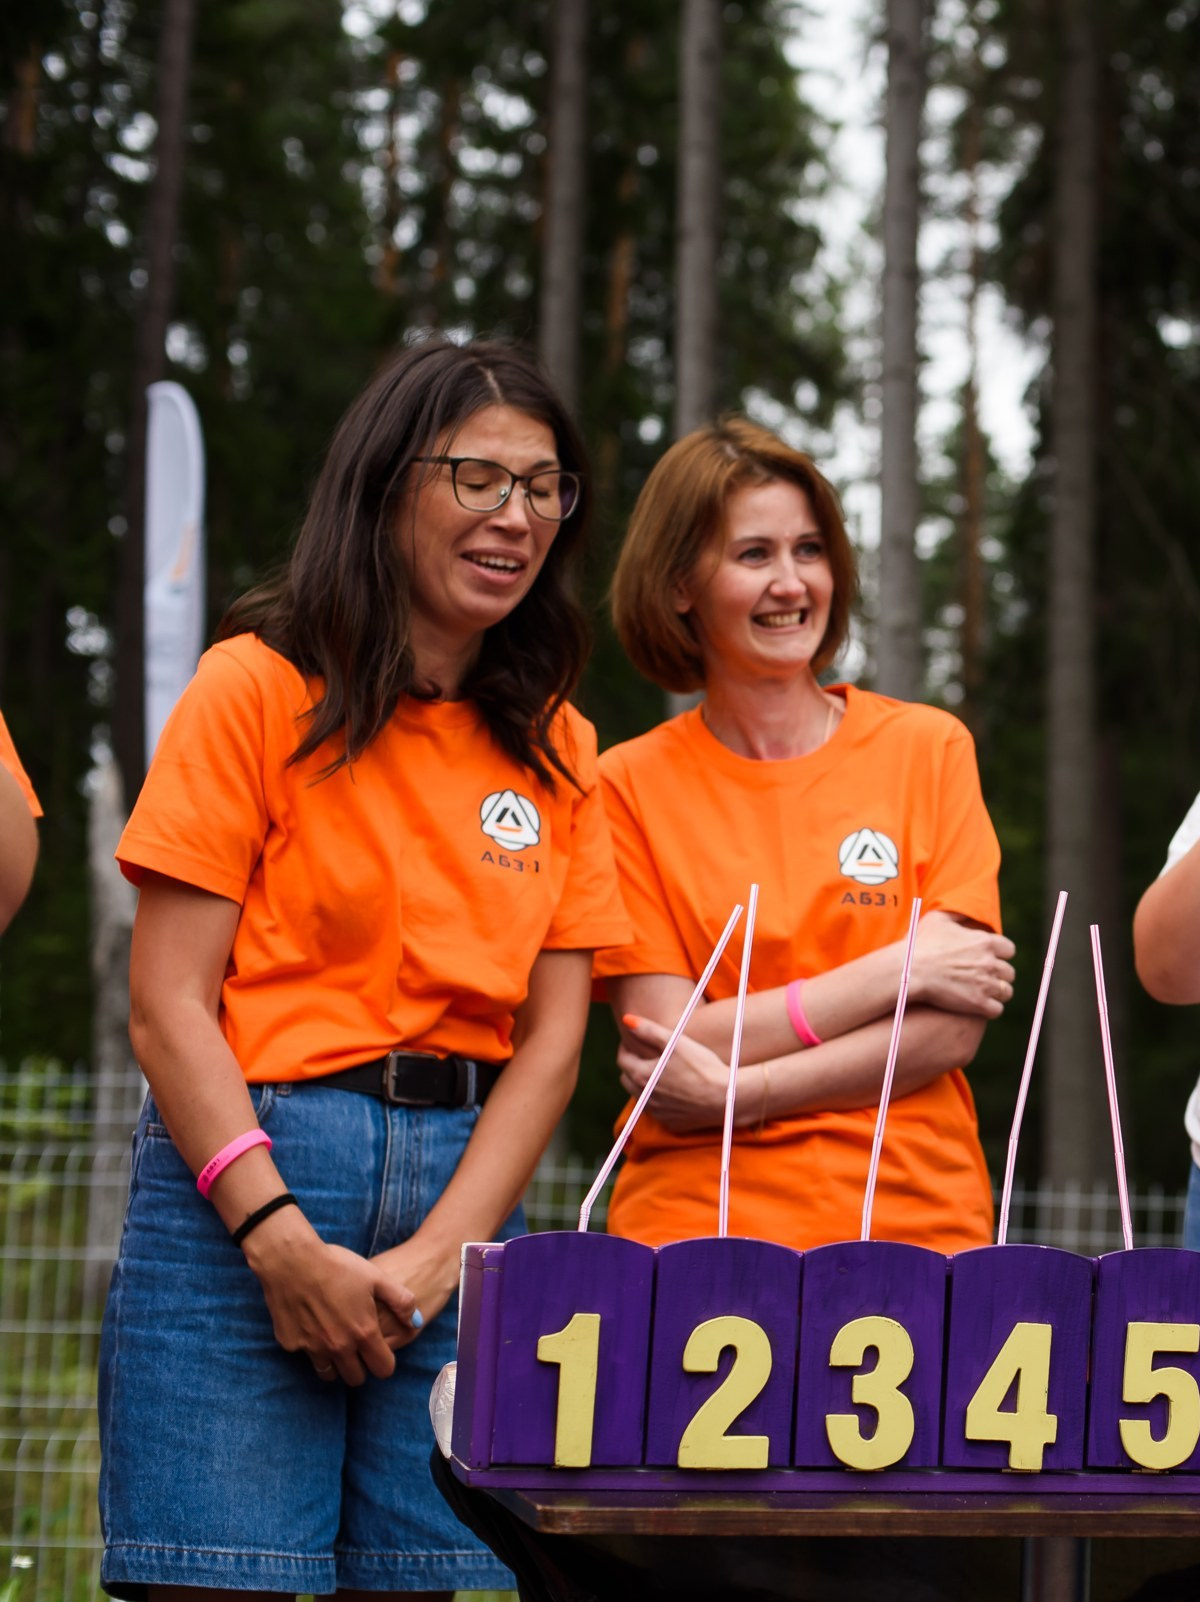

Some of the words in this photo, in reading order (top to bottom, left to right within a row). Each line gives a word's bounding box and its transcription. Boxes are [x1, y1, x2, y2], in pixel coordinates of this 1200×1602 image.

[537, 1313, 601, 1468] 1
[677, 1316, 773, 1470] 2
[825, 1316, 915, 1471] 3
[965, 1322, 1058, 1472] 4
